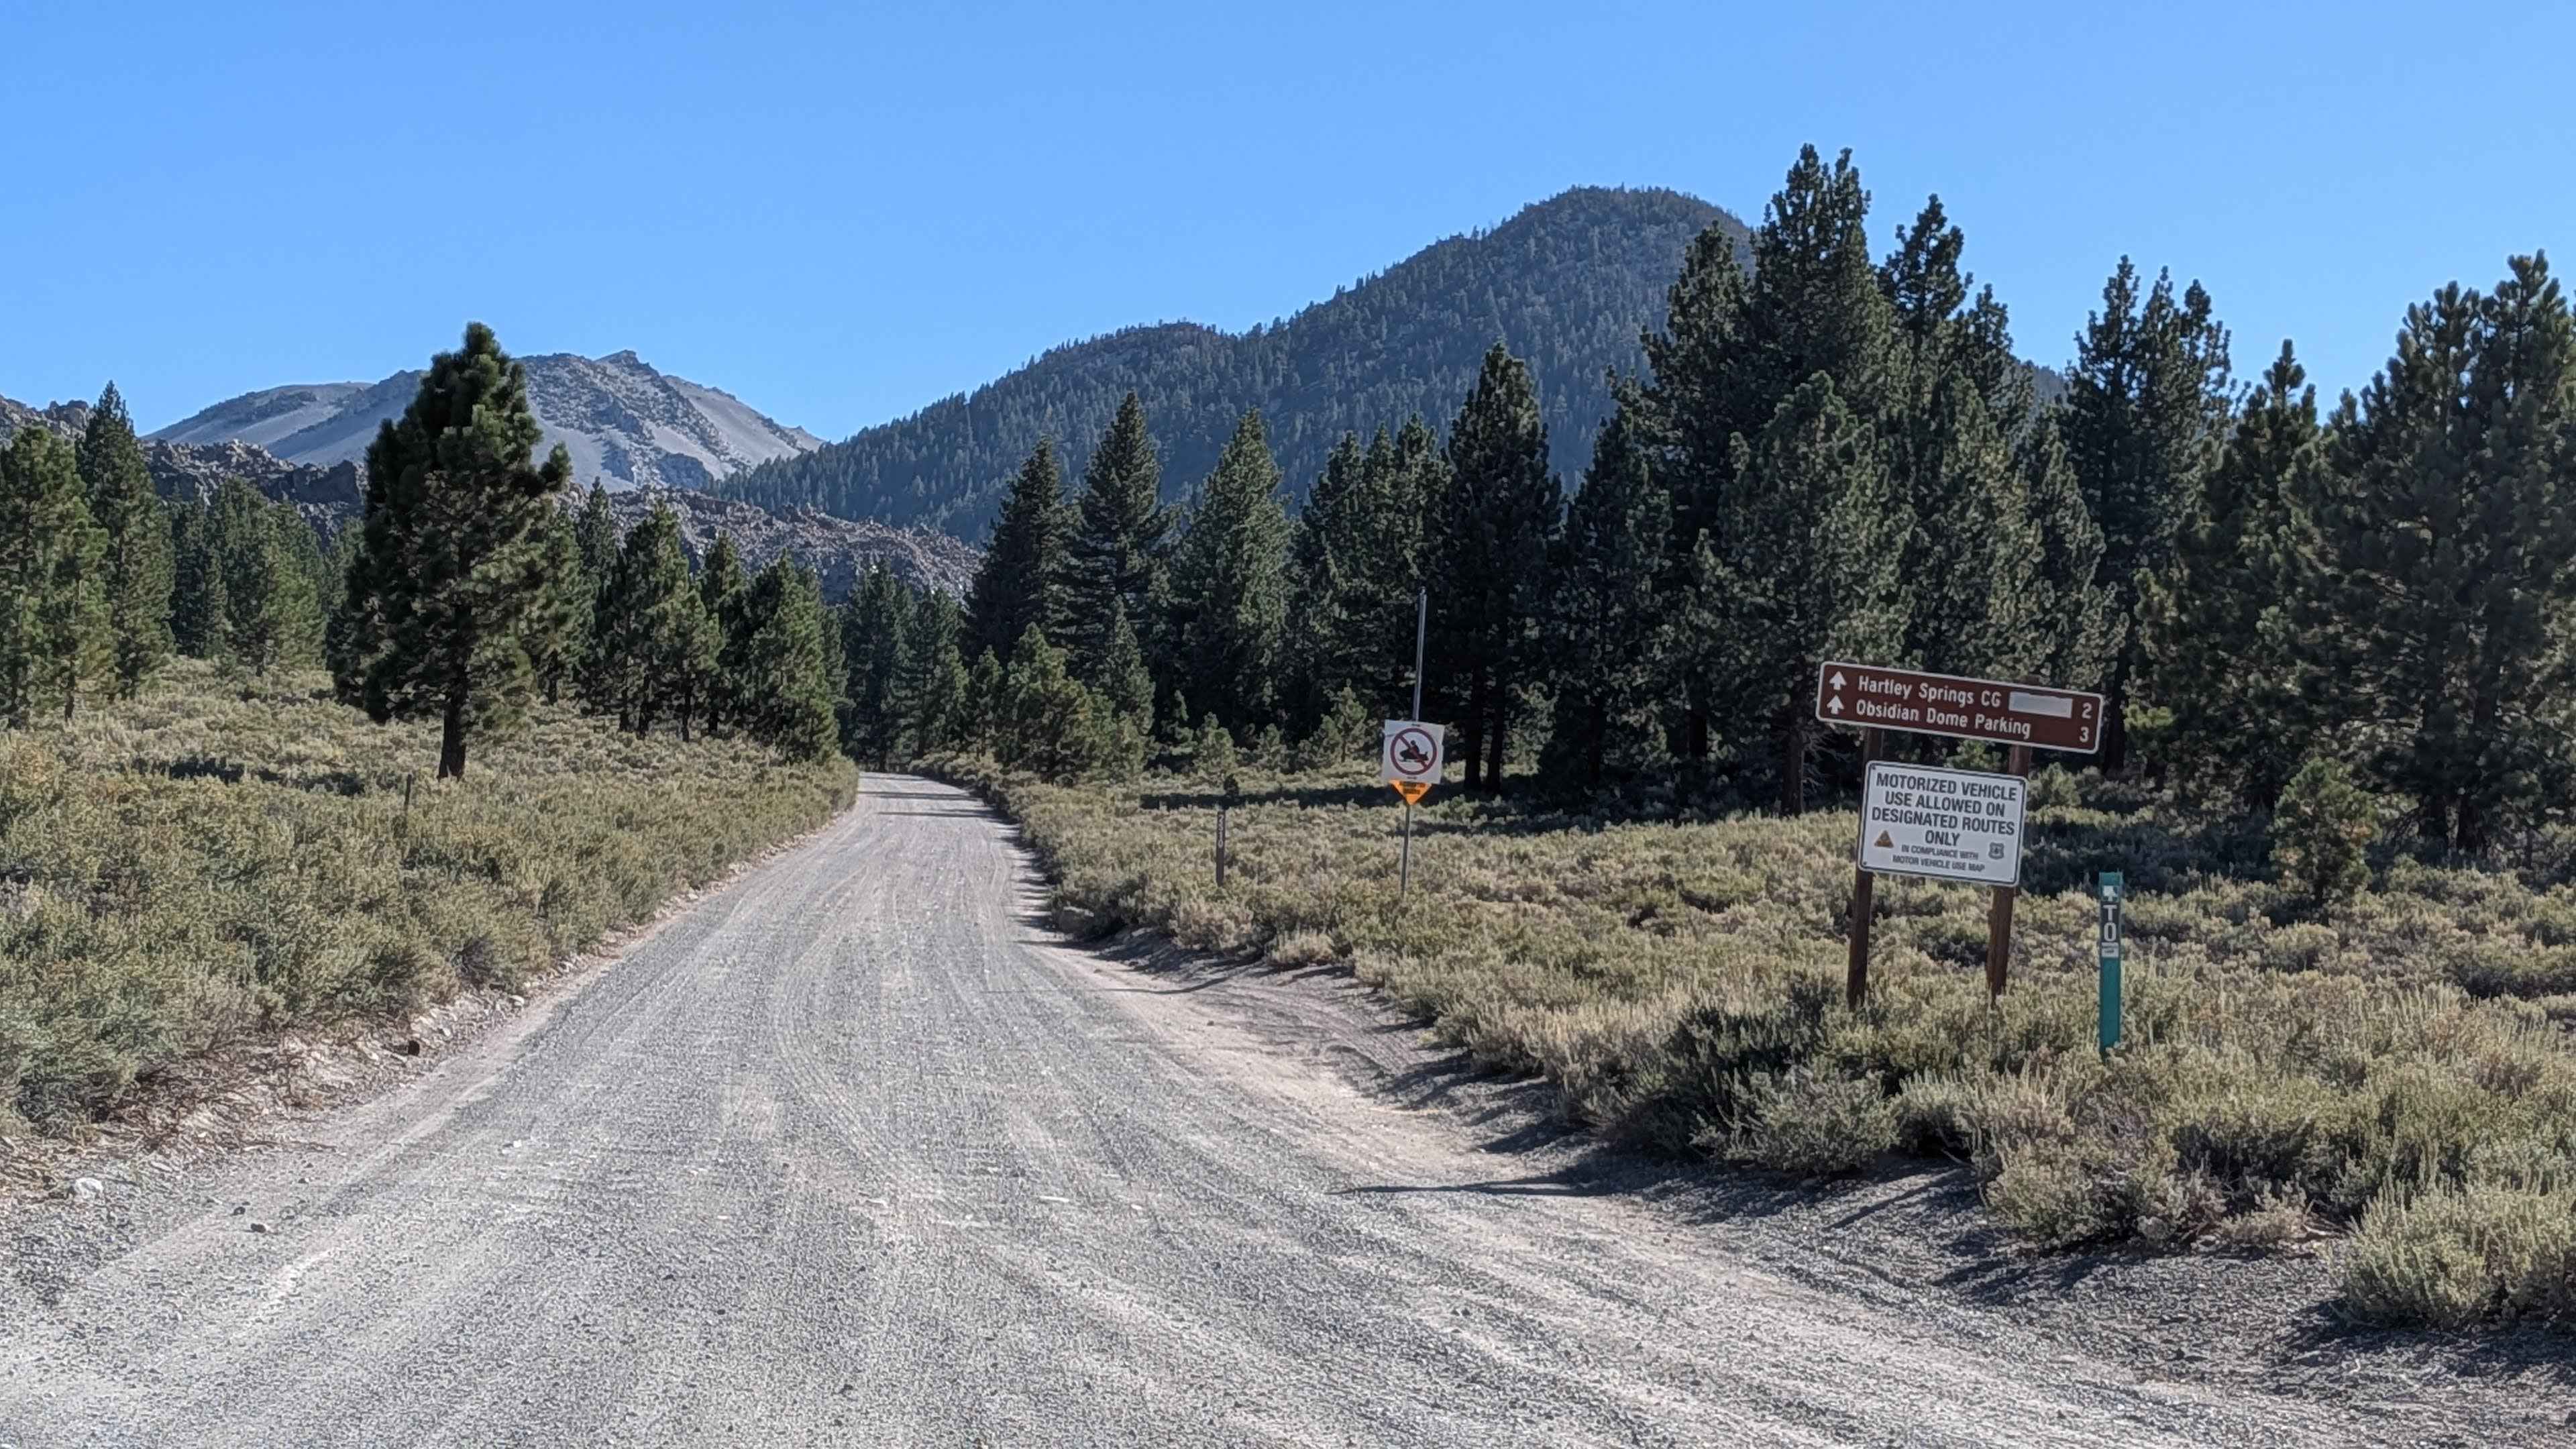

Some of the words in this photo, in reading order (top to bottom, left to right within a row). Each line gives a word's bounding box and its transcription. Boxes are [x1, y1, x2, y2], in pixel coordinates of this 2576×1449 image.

[1858, 675, 1912, 700] Hartley
[1918, 682, 1975, 708] Springs
[1980, 690, 2002, 708] CG
[2082, 702, 2093, 719] 2
[1856, 699, 1919, 721] Obsidian
[1926, 707, 1968, 728] Dome
[1974, 714, 2031, 739] Parking
[2079, 727, 2090, 743] 3
[1876, 773, 1957, 794] MOTORIZED
[1961, 782, 2017, 801] VEHICLE
[1885, 791, 1913, 806] USE
[1915, 794, 1982, 814] ALLOWED
[1986, 802, 2005, 817] ON
[1872, 806, 1957, 829] DESIGNATED
[1962, 818, 2015, 836] ROUTES
[1901, 844, 1909, 853] IN
[1911, 845, 1958, 859] COMPLIANCE
[1960, 850, 1979, 860] WITH
[1925, 830, 1960, 847] ONLY
[1892, 855, 1919, 865] MOTOR
[1921, 858, 1950, 869] VEHICLE
[1952, 861, 1966, 871] USE
[1968, 863, 1985, 872] MAP
